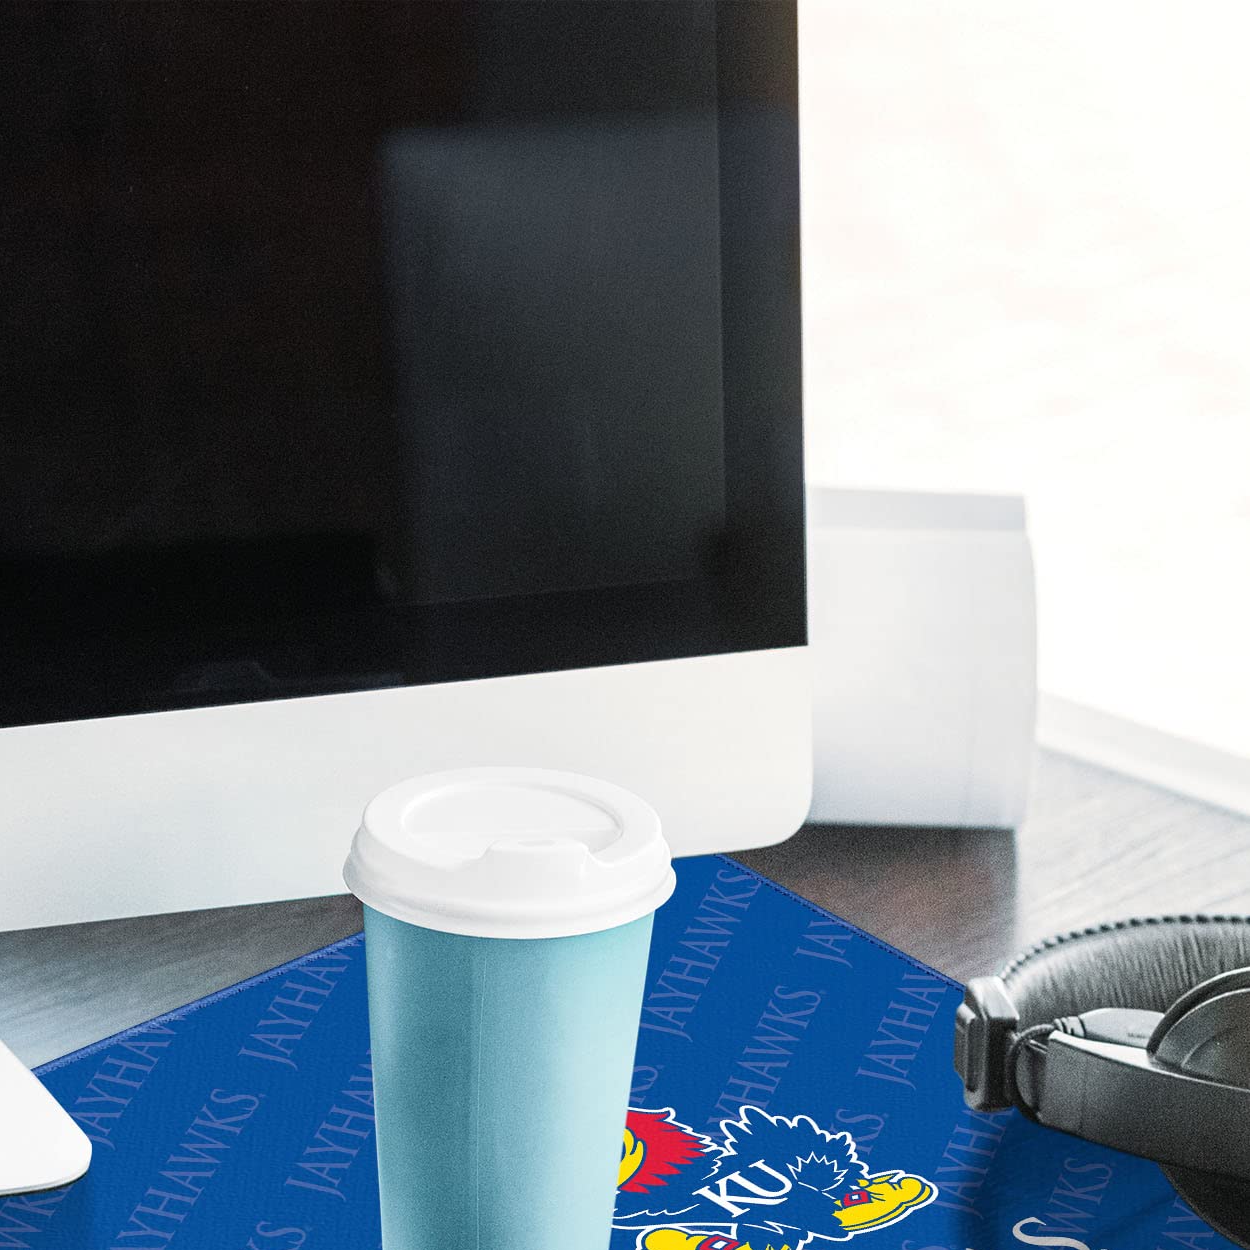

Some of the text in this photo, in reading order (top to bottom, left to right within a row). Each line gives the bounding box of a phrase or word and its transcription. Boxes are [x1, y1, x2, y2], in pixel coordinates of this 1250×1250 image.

[238, 943, 361, 1071] JAYHA
[640, 868, 763, 1042] JAYHAWKS
[68, 1015, 186, 1151] AYHA
[699, 985, 822, 1144] YHAWKS
[855, 972, 948, 1090] JAYHA
[284, 1048, 376, 1202] JAYHA
[691, 1159, 792, 1218] KU
[931, 1106, 1015, 1219] JAYHA
